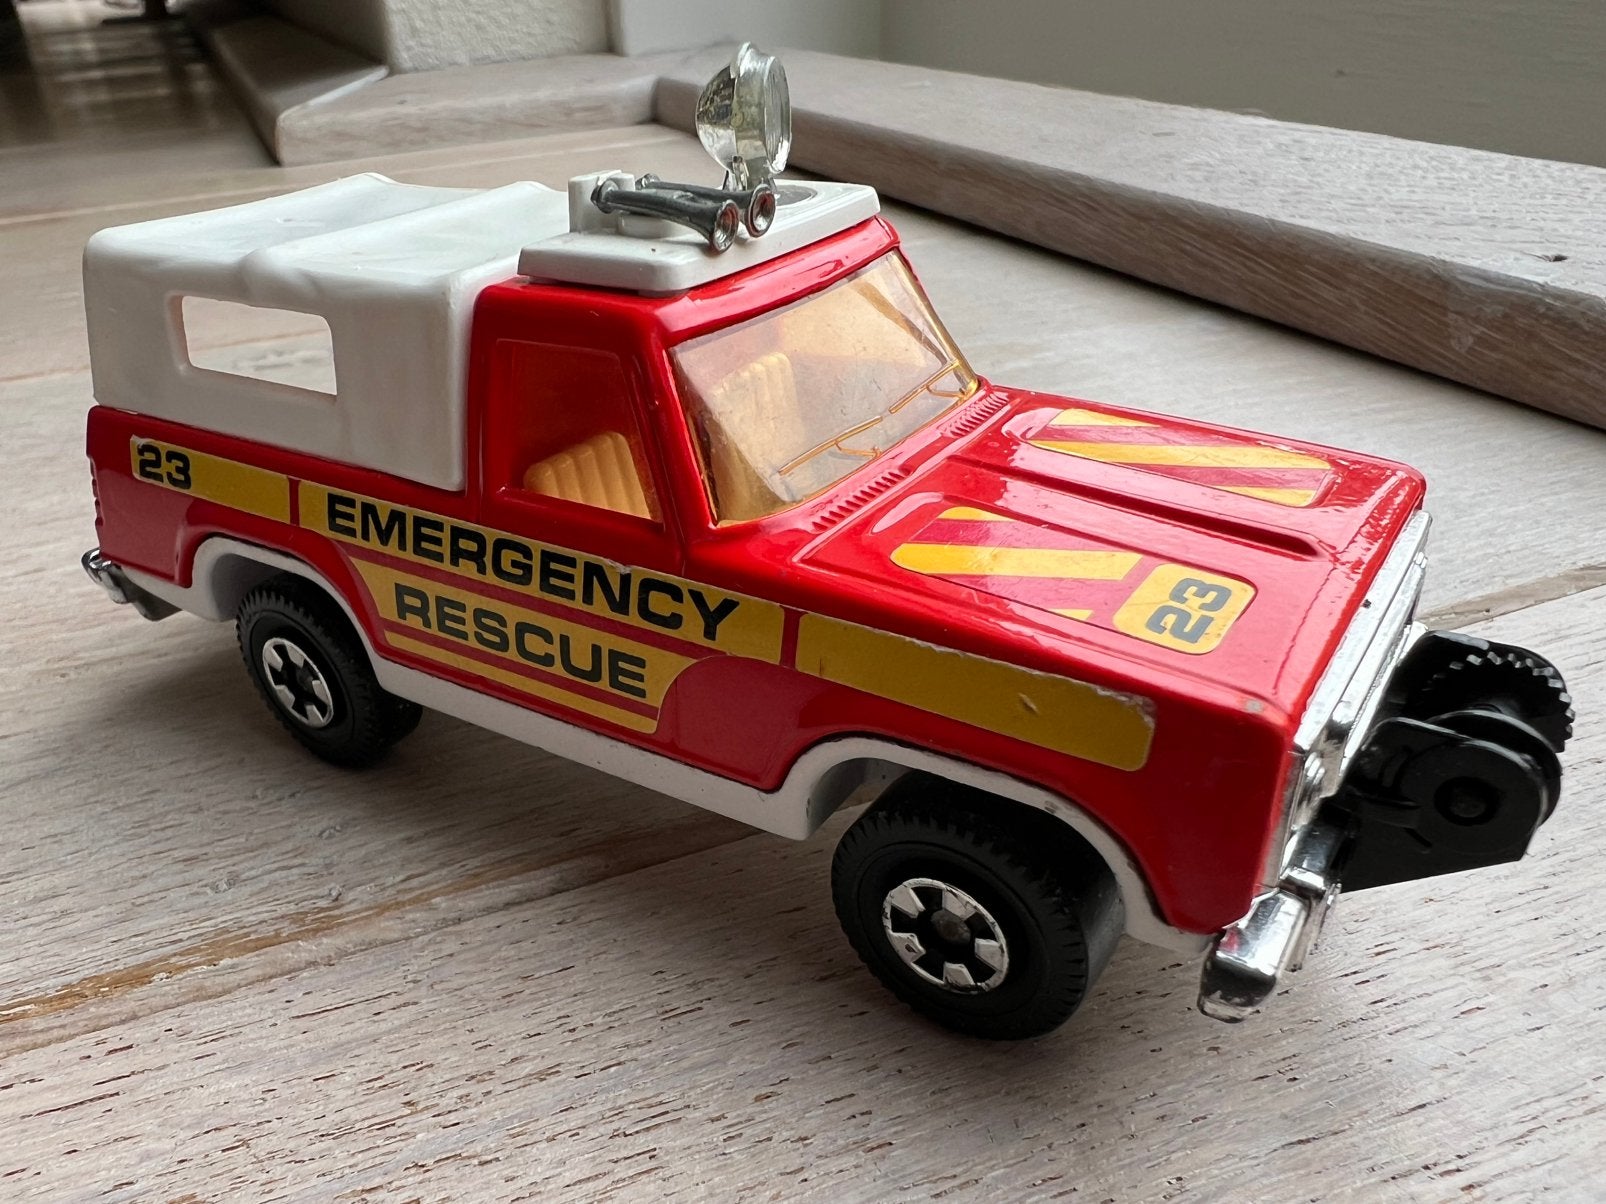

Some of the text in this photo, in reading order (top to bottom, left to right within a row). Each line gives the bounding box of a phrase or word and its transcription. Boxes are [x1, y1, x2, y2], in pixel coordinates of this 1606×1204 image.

[137, 443, 192, 490] 23
[327, 492, 740, 641] EMERGENCY
[1145, 577, 1233, 645] 23
[394, 582, 647, 699] RESCUE
